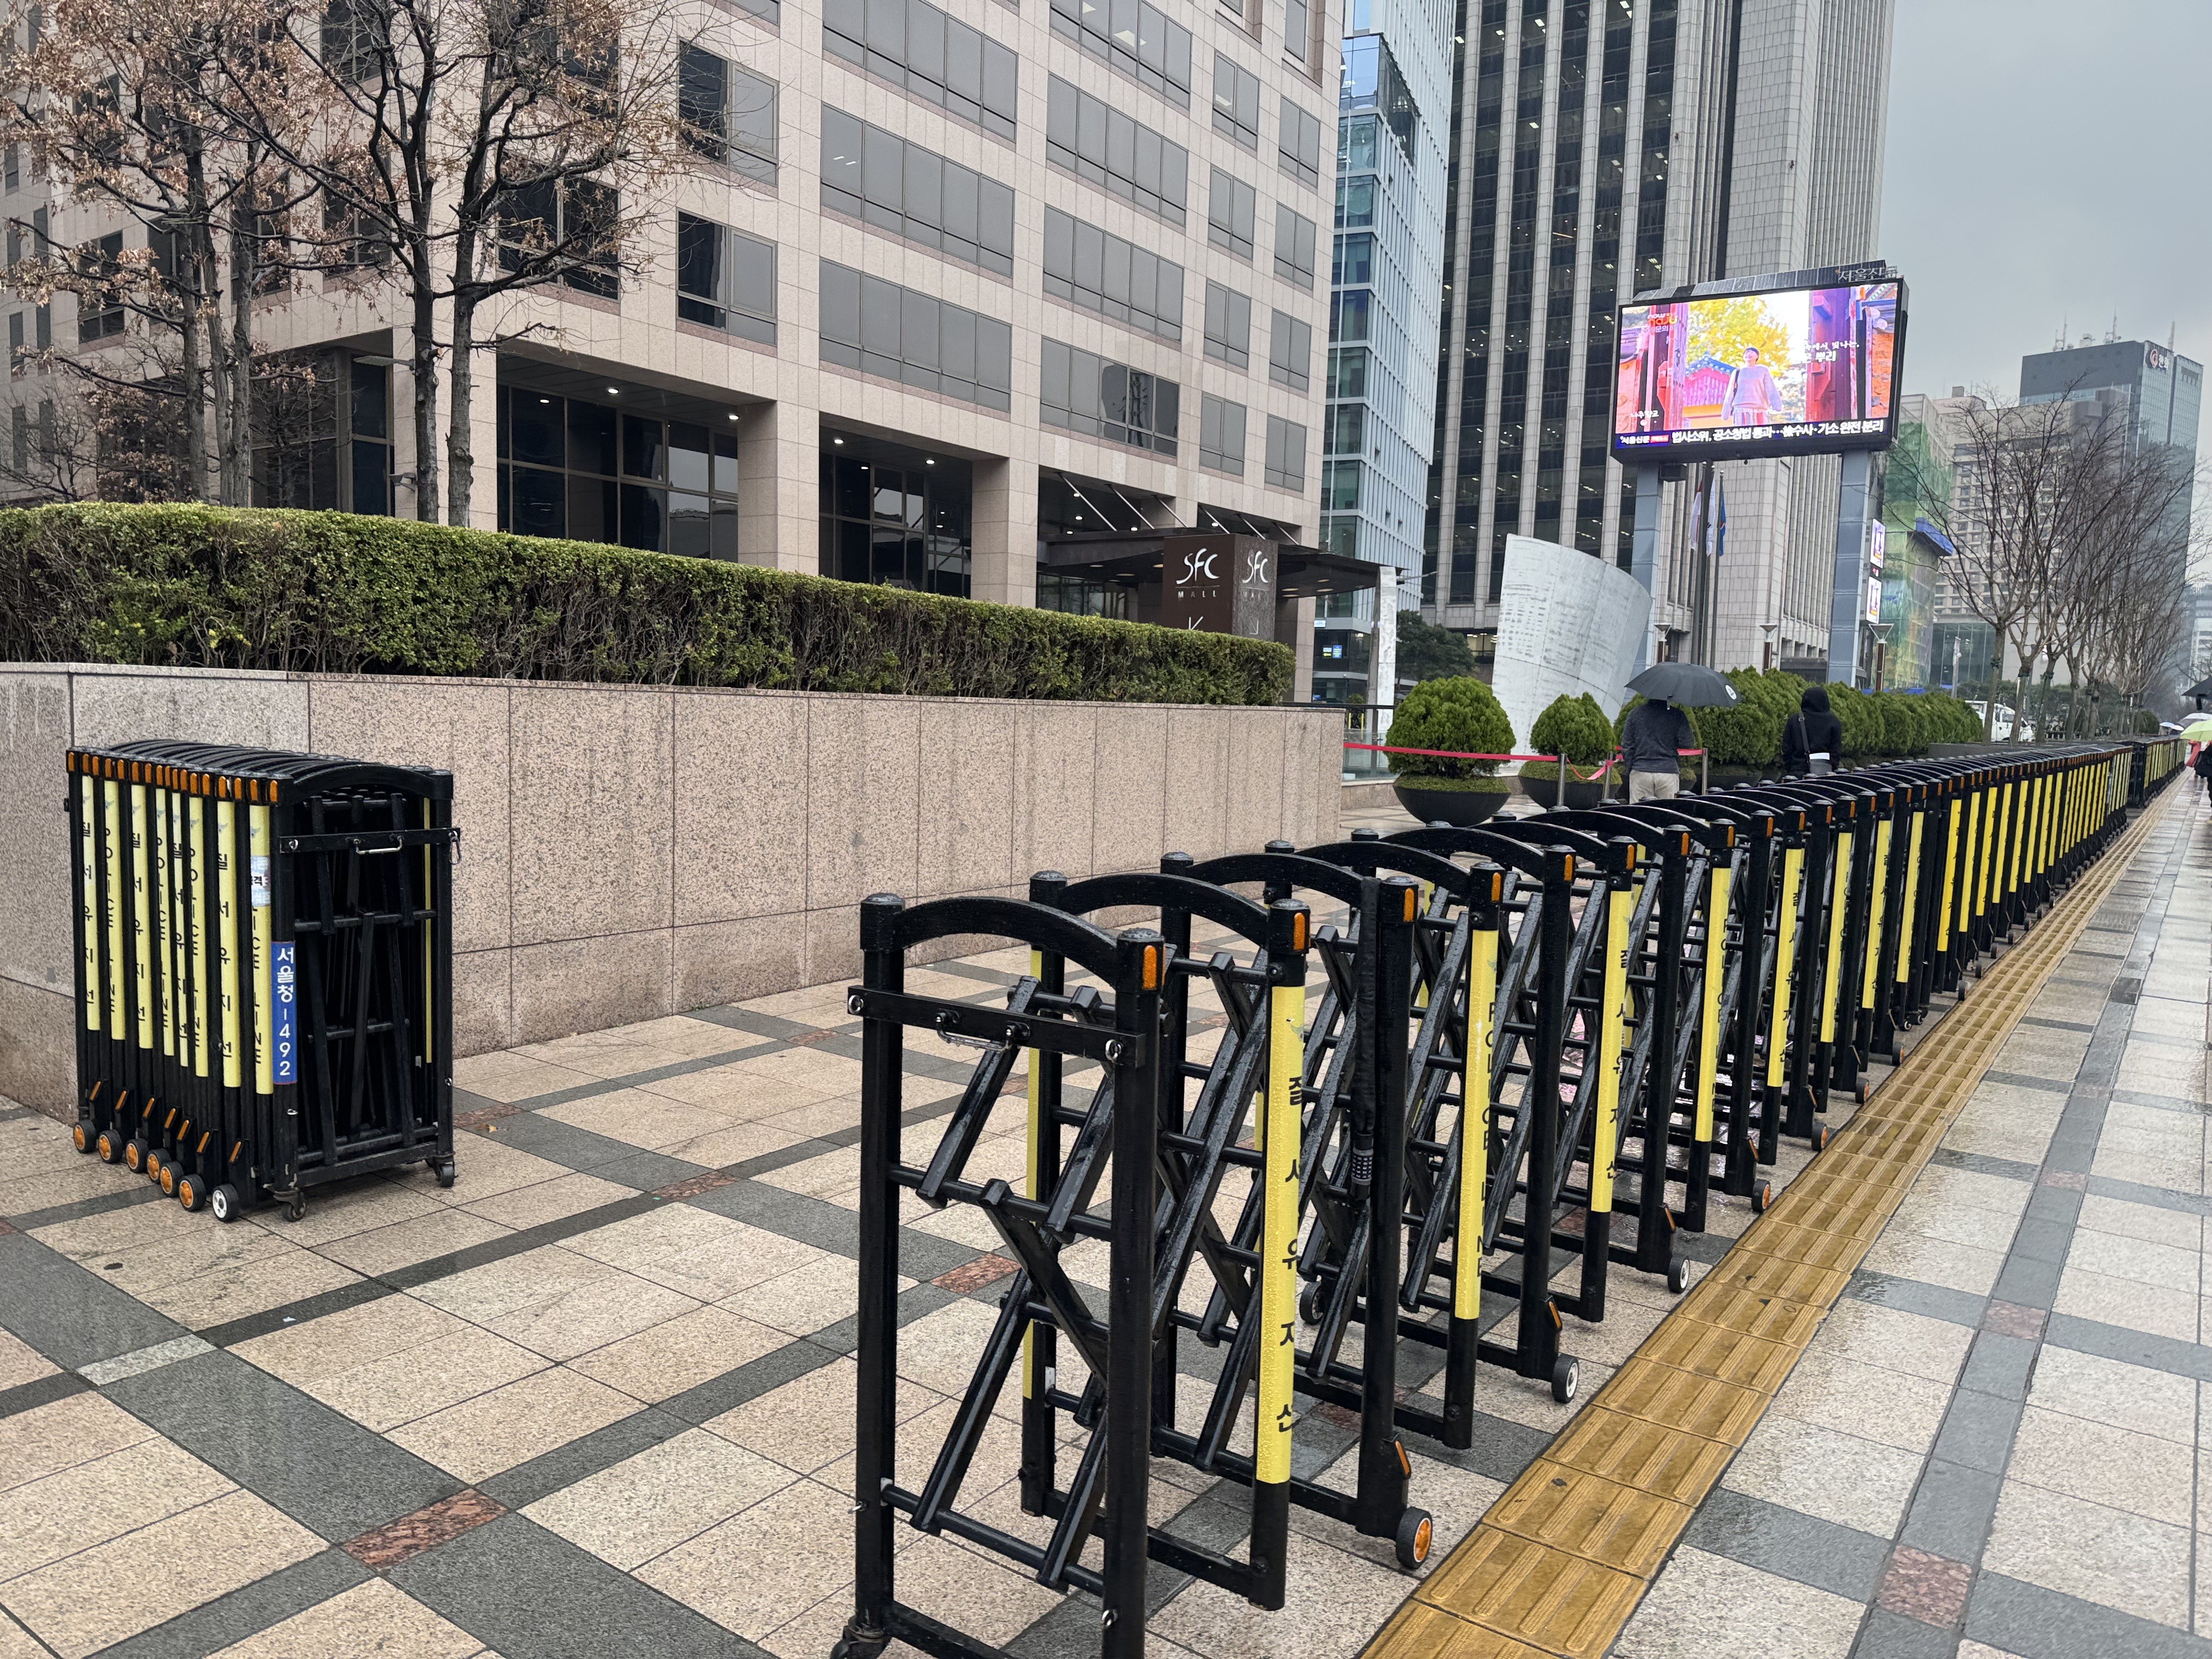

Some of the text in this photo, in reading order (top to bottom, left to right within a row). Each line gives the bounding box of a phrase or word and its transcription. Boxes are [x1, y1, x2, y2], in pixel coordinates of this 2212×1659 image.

[1838, 267, 1898, 284] 서울신문
[1815, 351, 1836, 362] 뿌리
[1839, 421, 1861, 435] 완전
[1861, 419, 1884, 433] 분리
[1178, 590, 1217, 599] MALL
